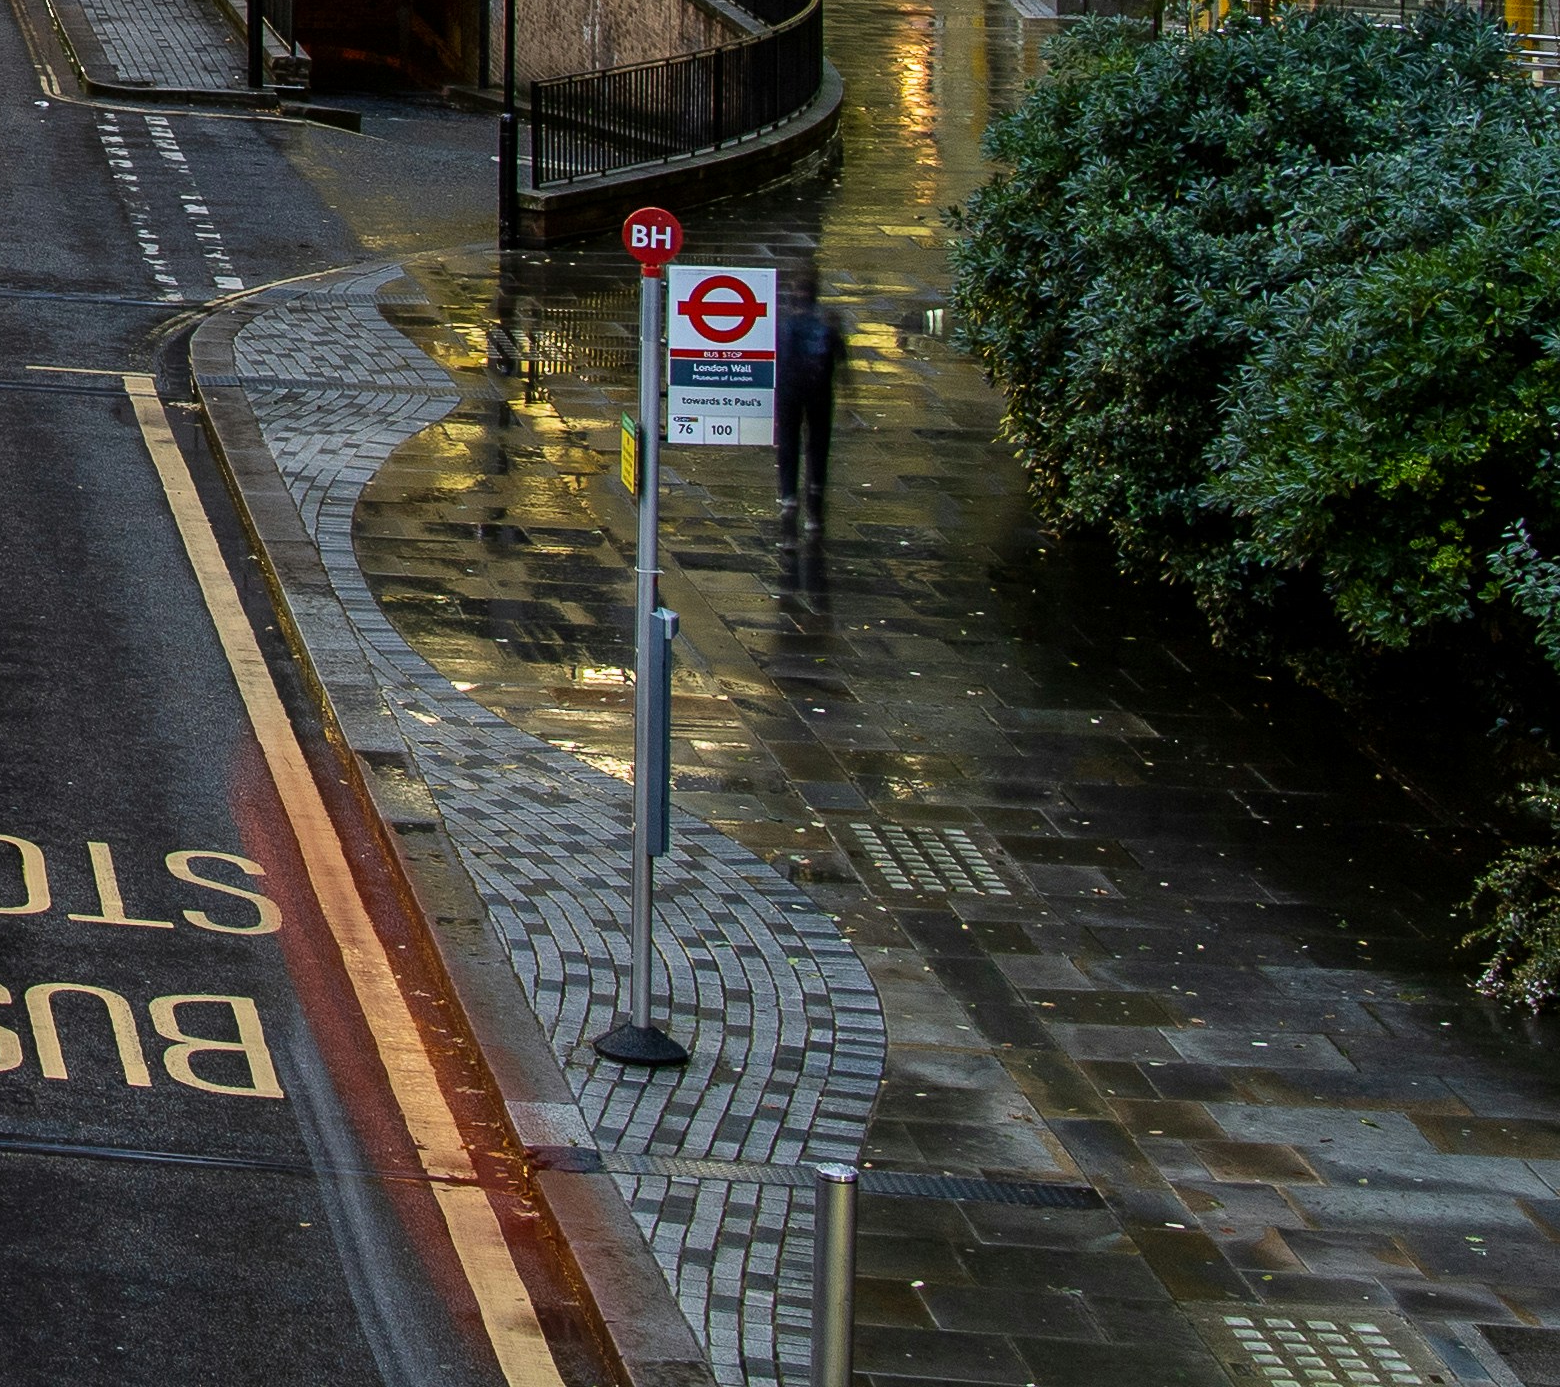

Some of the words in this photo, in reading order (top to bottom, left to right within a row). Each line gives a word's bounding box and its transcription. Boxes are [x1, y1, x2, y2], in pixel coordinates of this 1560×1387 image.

[631, 224, 672, 249] BH
[693, 363, 728, 373] London
[730, 364, 752, 373] Wall
[681, 397, 720, 405] towards
[722, 397, 732, 406] St
[734, 398, 762, 407] Paul's
[678, 423, 694, 434] 76
[711, 425, 733, 436] 100
